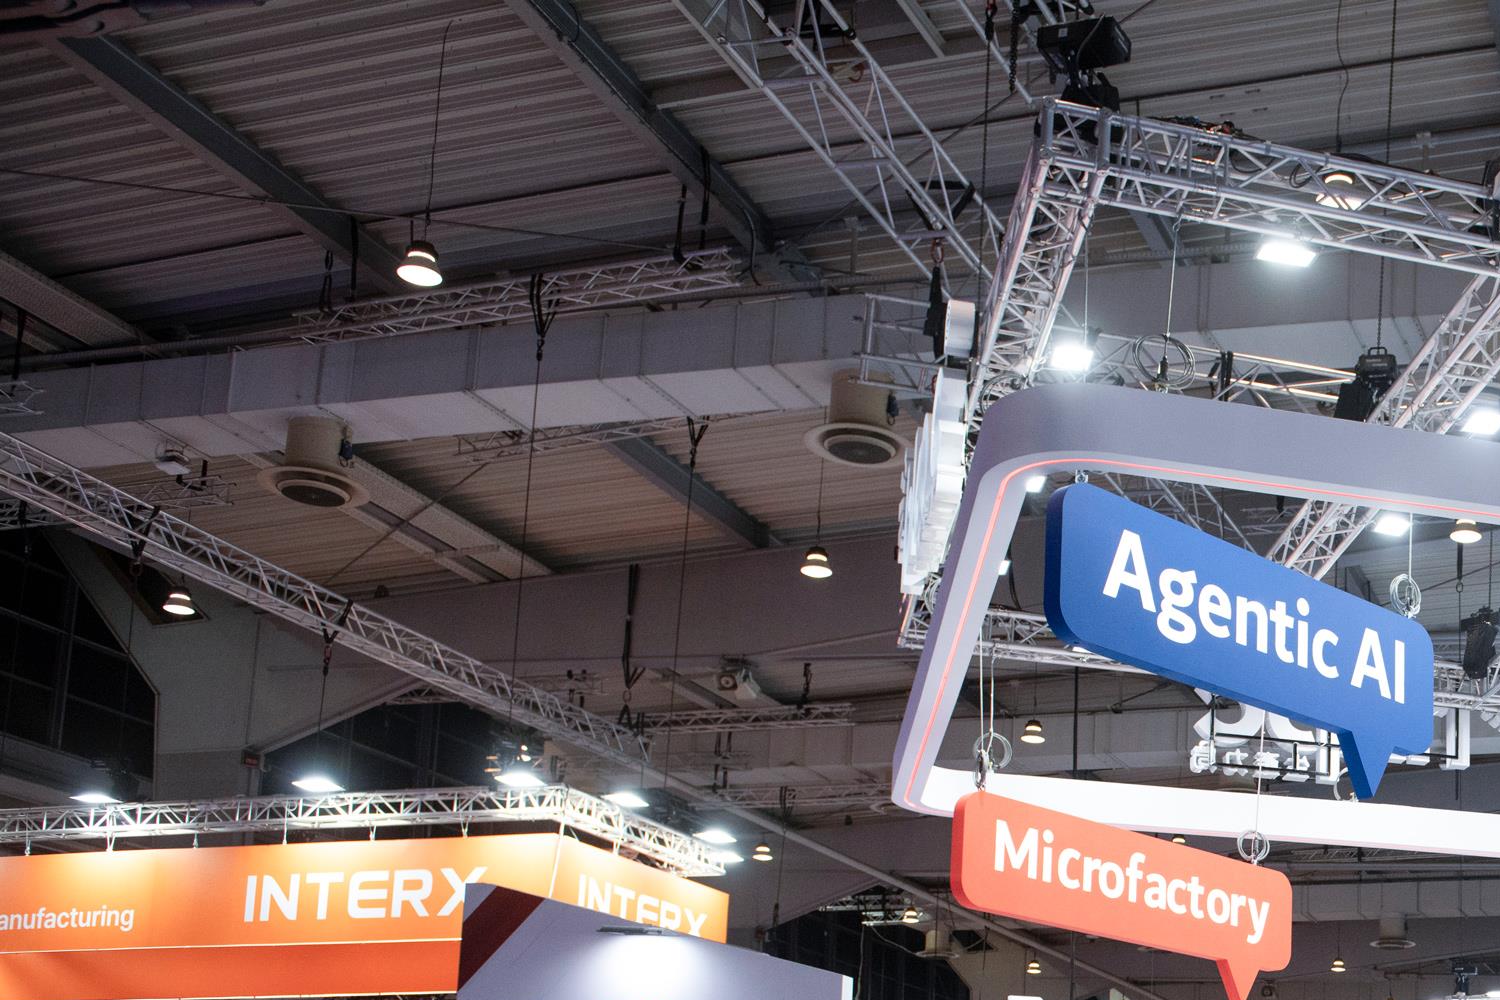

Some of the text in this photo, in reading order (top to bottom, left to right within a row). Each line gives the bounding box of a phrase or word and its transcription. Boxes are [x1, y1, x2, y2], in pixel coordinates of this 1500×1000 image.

[1102, 529, 1405, 704] Agentic AI
[243, 866, 488, 922] INTERX
[994, 819, 1270, 944] Microfactory
